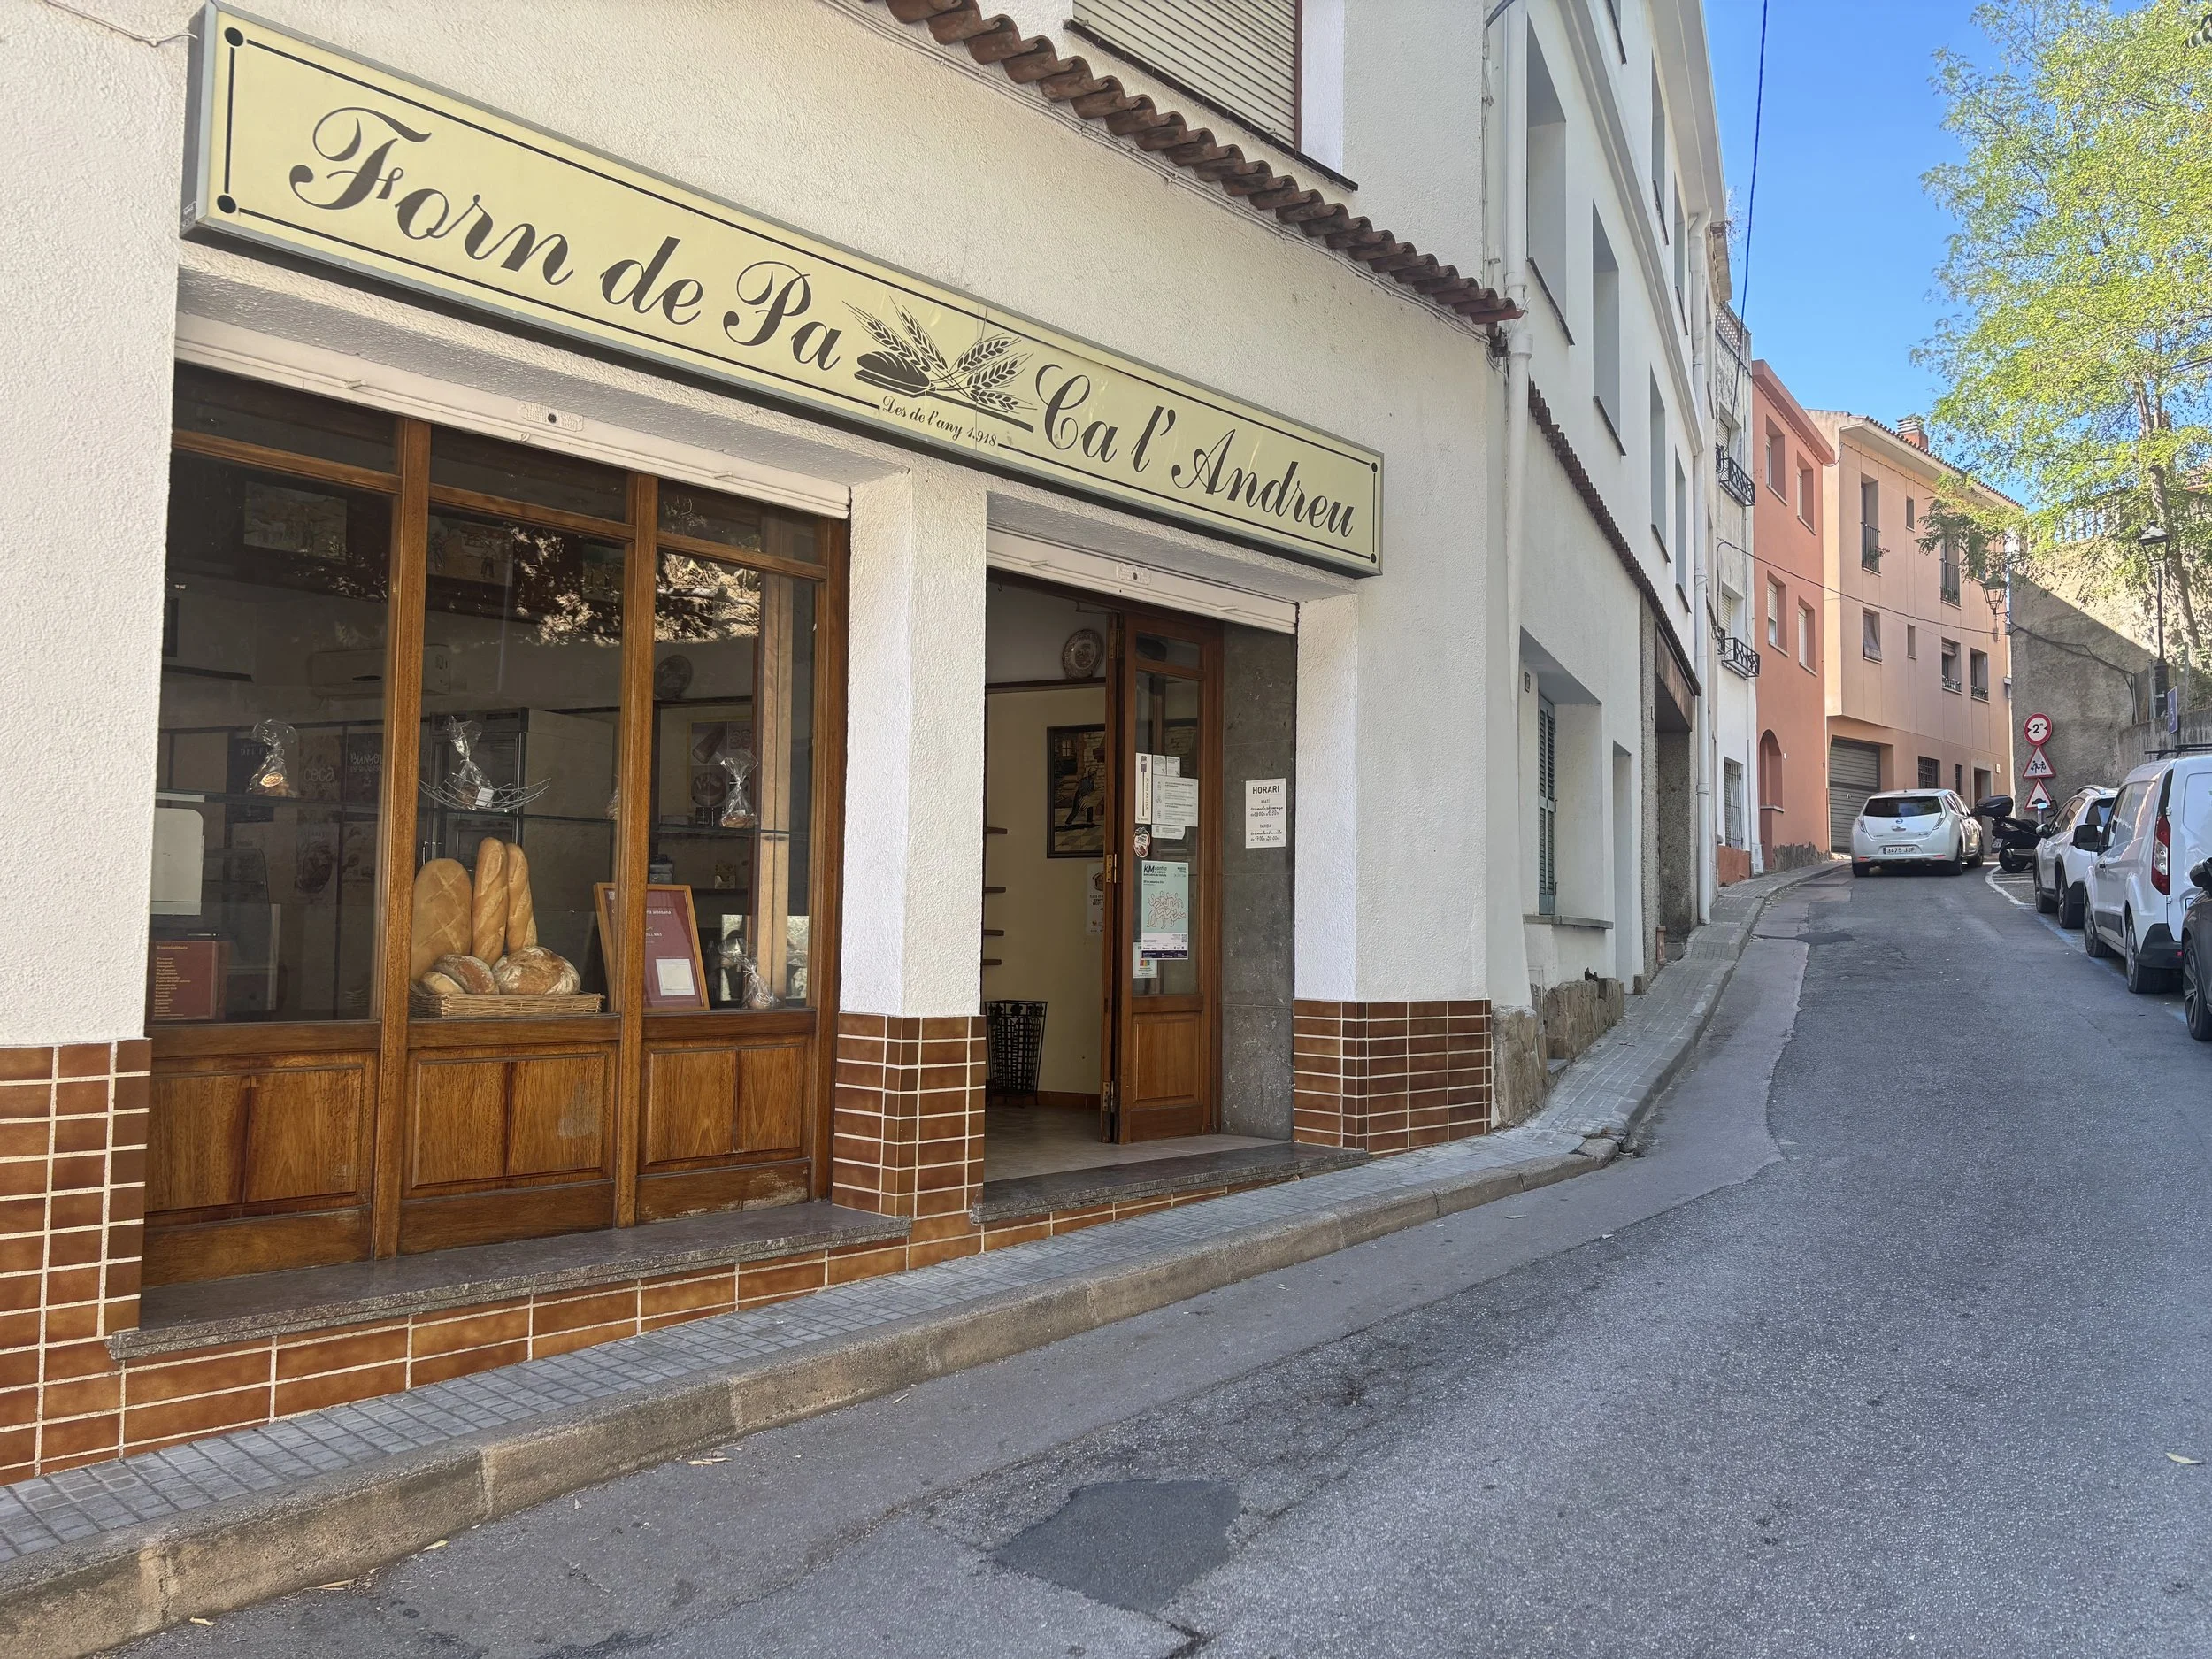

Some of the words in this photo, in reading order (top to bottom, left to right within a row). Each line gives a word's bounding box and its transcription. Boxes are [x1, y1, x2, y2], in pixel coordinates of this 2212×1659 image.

[289, 107, 573, 286] Forn
[600, 236, 704, 326] de
[722, 260, 841, 372] Pa
[882, 395, 907, 419] Des
[910, 407, 926, 424] de
[1035, 363, 1118, 463] Ca
[1252, 786, 1279, 795] HORARI
